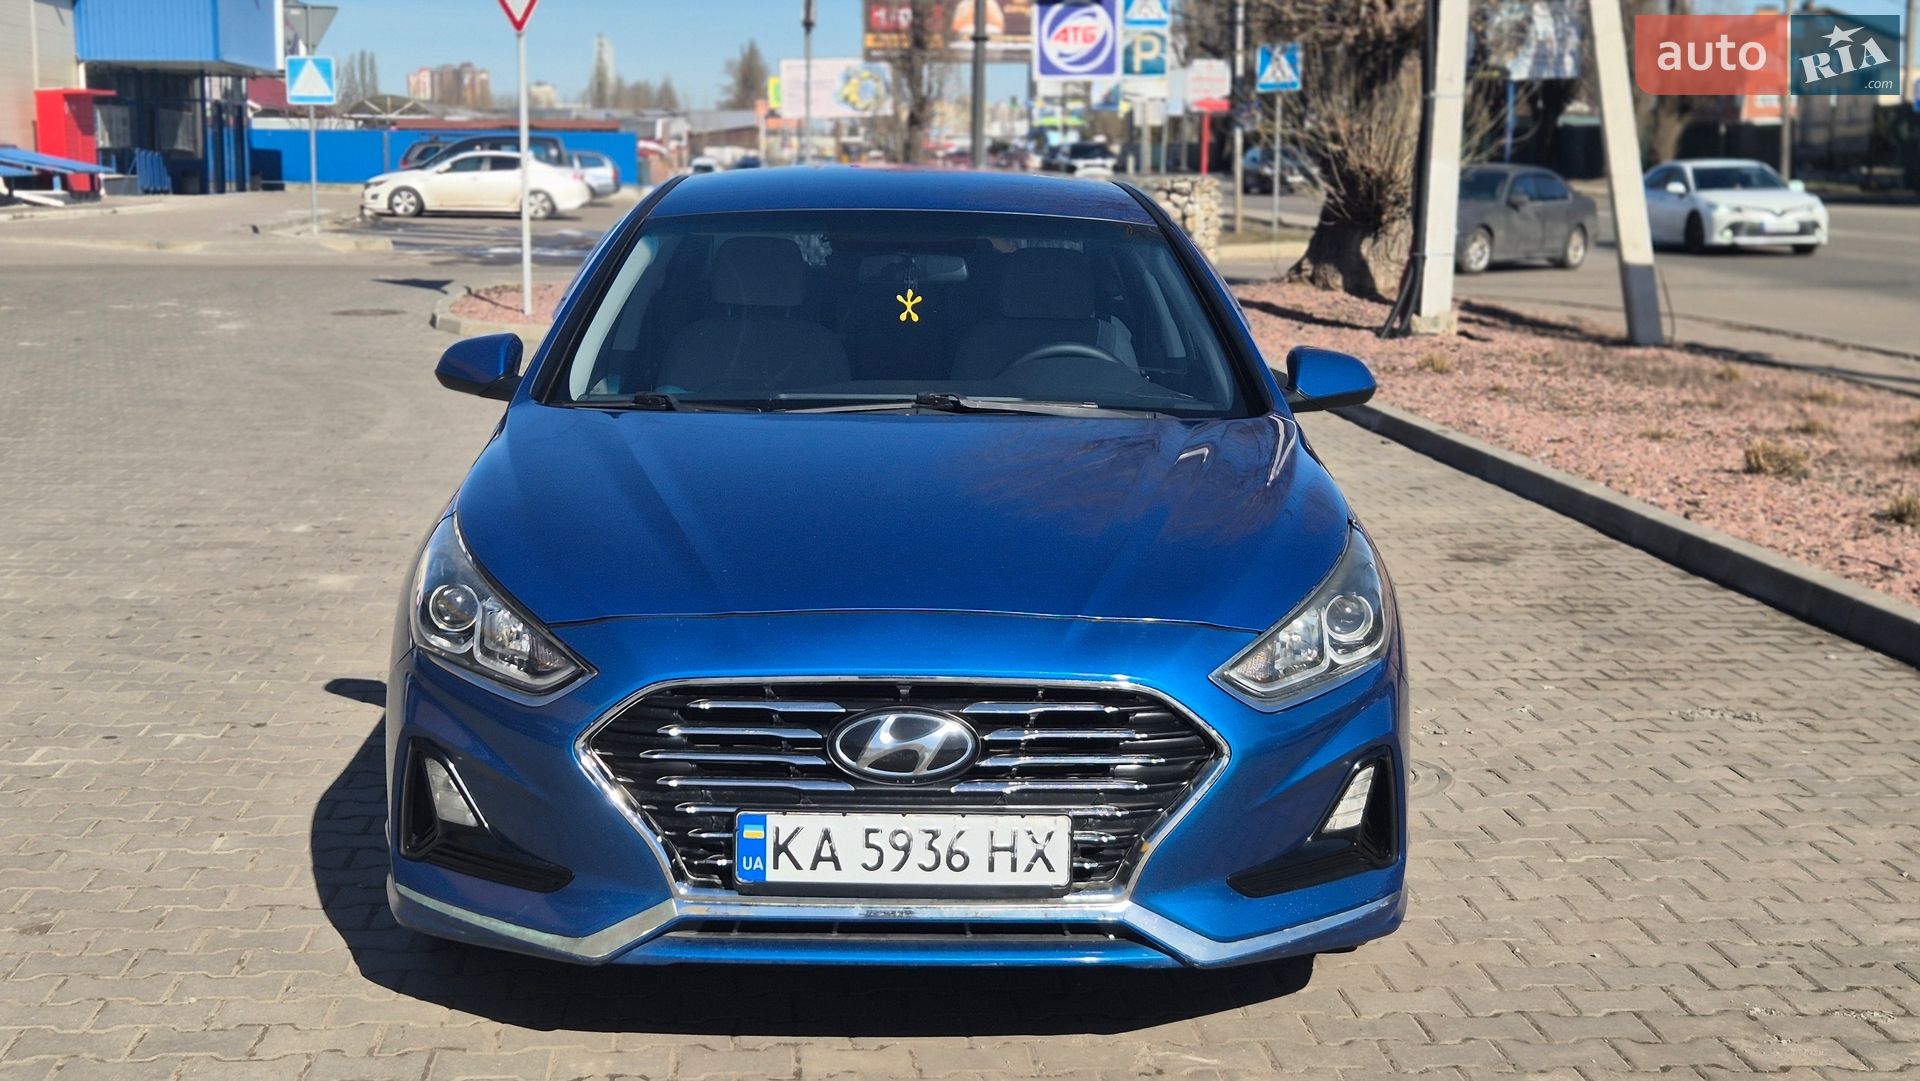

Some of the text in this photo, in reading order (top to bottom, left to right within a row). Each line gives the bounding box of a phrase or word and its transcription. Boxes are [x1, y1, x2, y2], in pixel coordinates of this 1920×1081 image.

[1052, 25, 1097, 44] АТБ
[772, 826, 1056, 873] KA 5936 HX
[743, 856, 763, 870] UA
